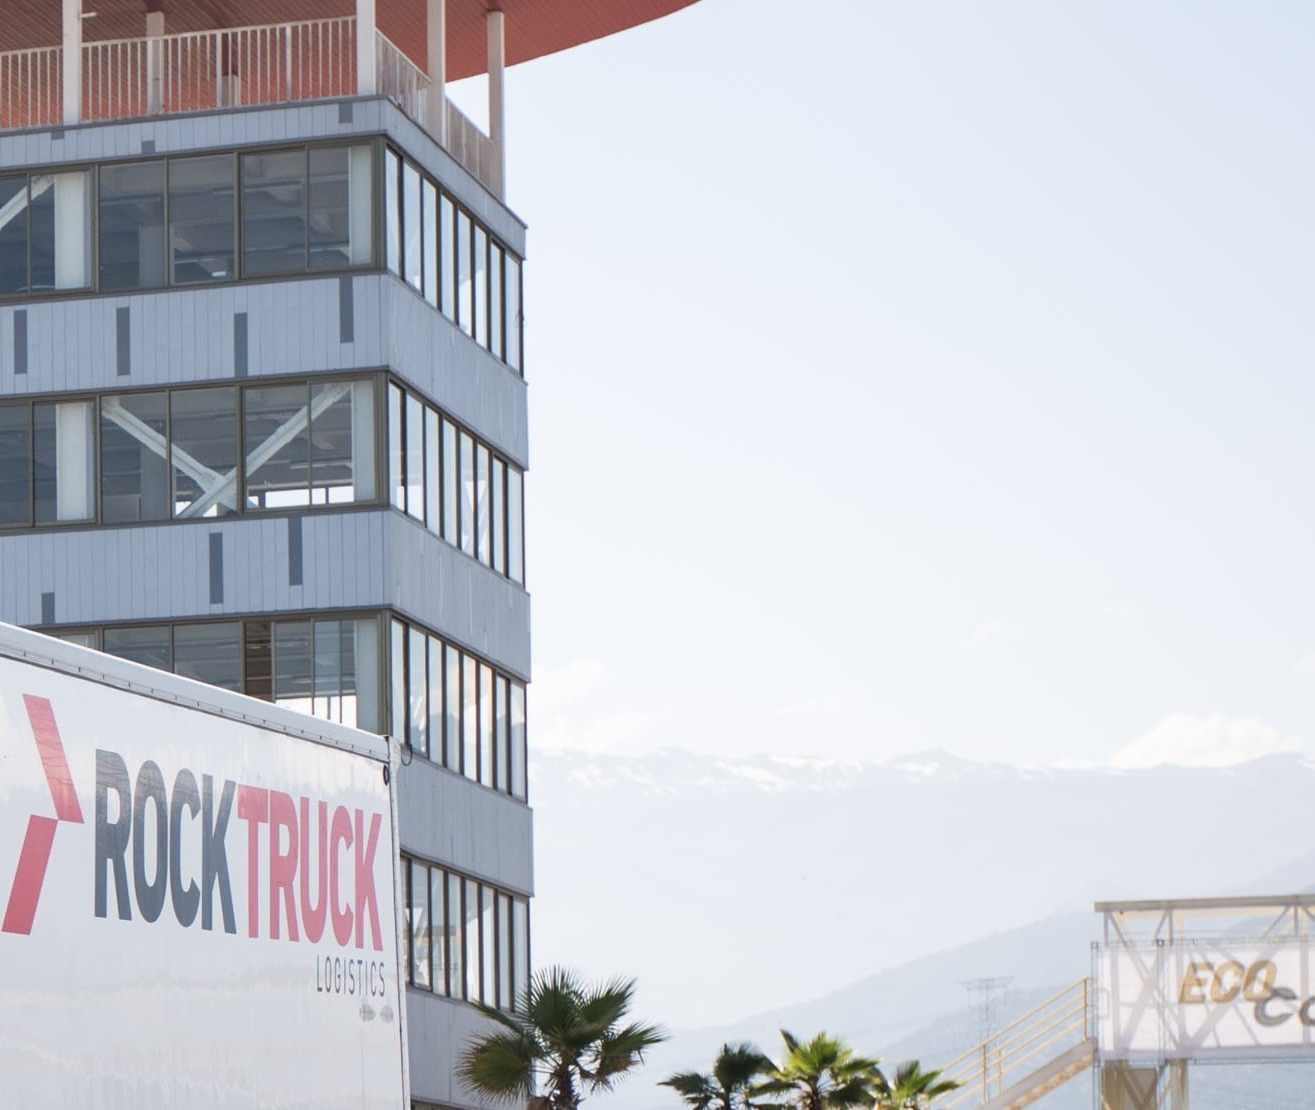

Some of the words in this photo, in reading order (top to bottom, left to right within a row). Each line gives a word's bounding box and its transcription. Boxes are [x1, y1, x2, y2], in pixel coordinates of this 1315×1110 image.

[95, 748, 384, 952] ROCKTRUCK
[316, 955, 386, 998] LOGISTICS
[1179, 960, 1277, 1004] ECO
